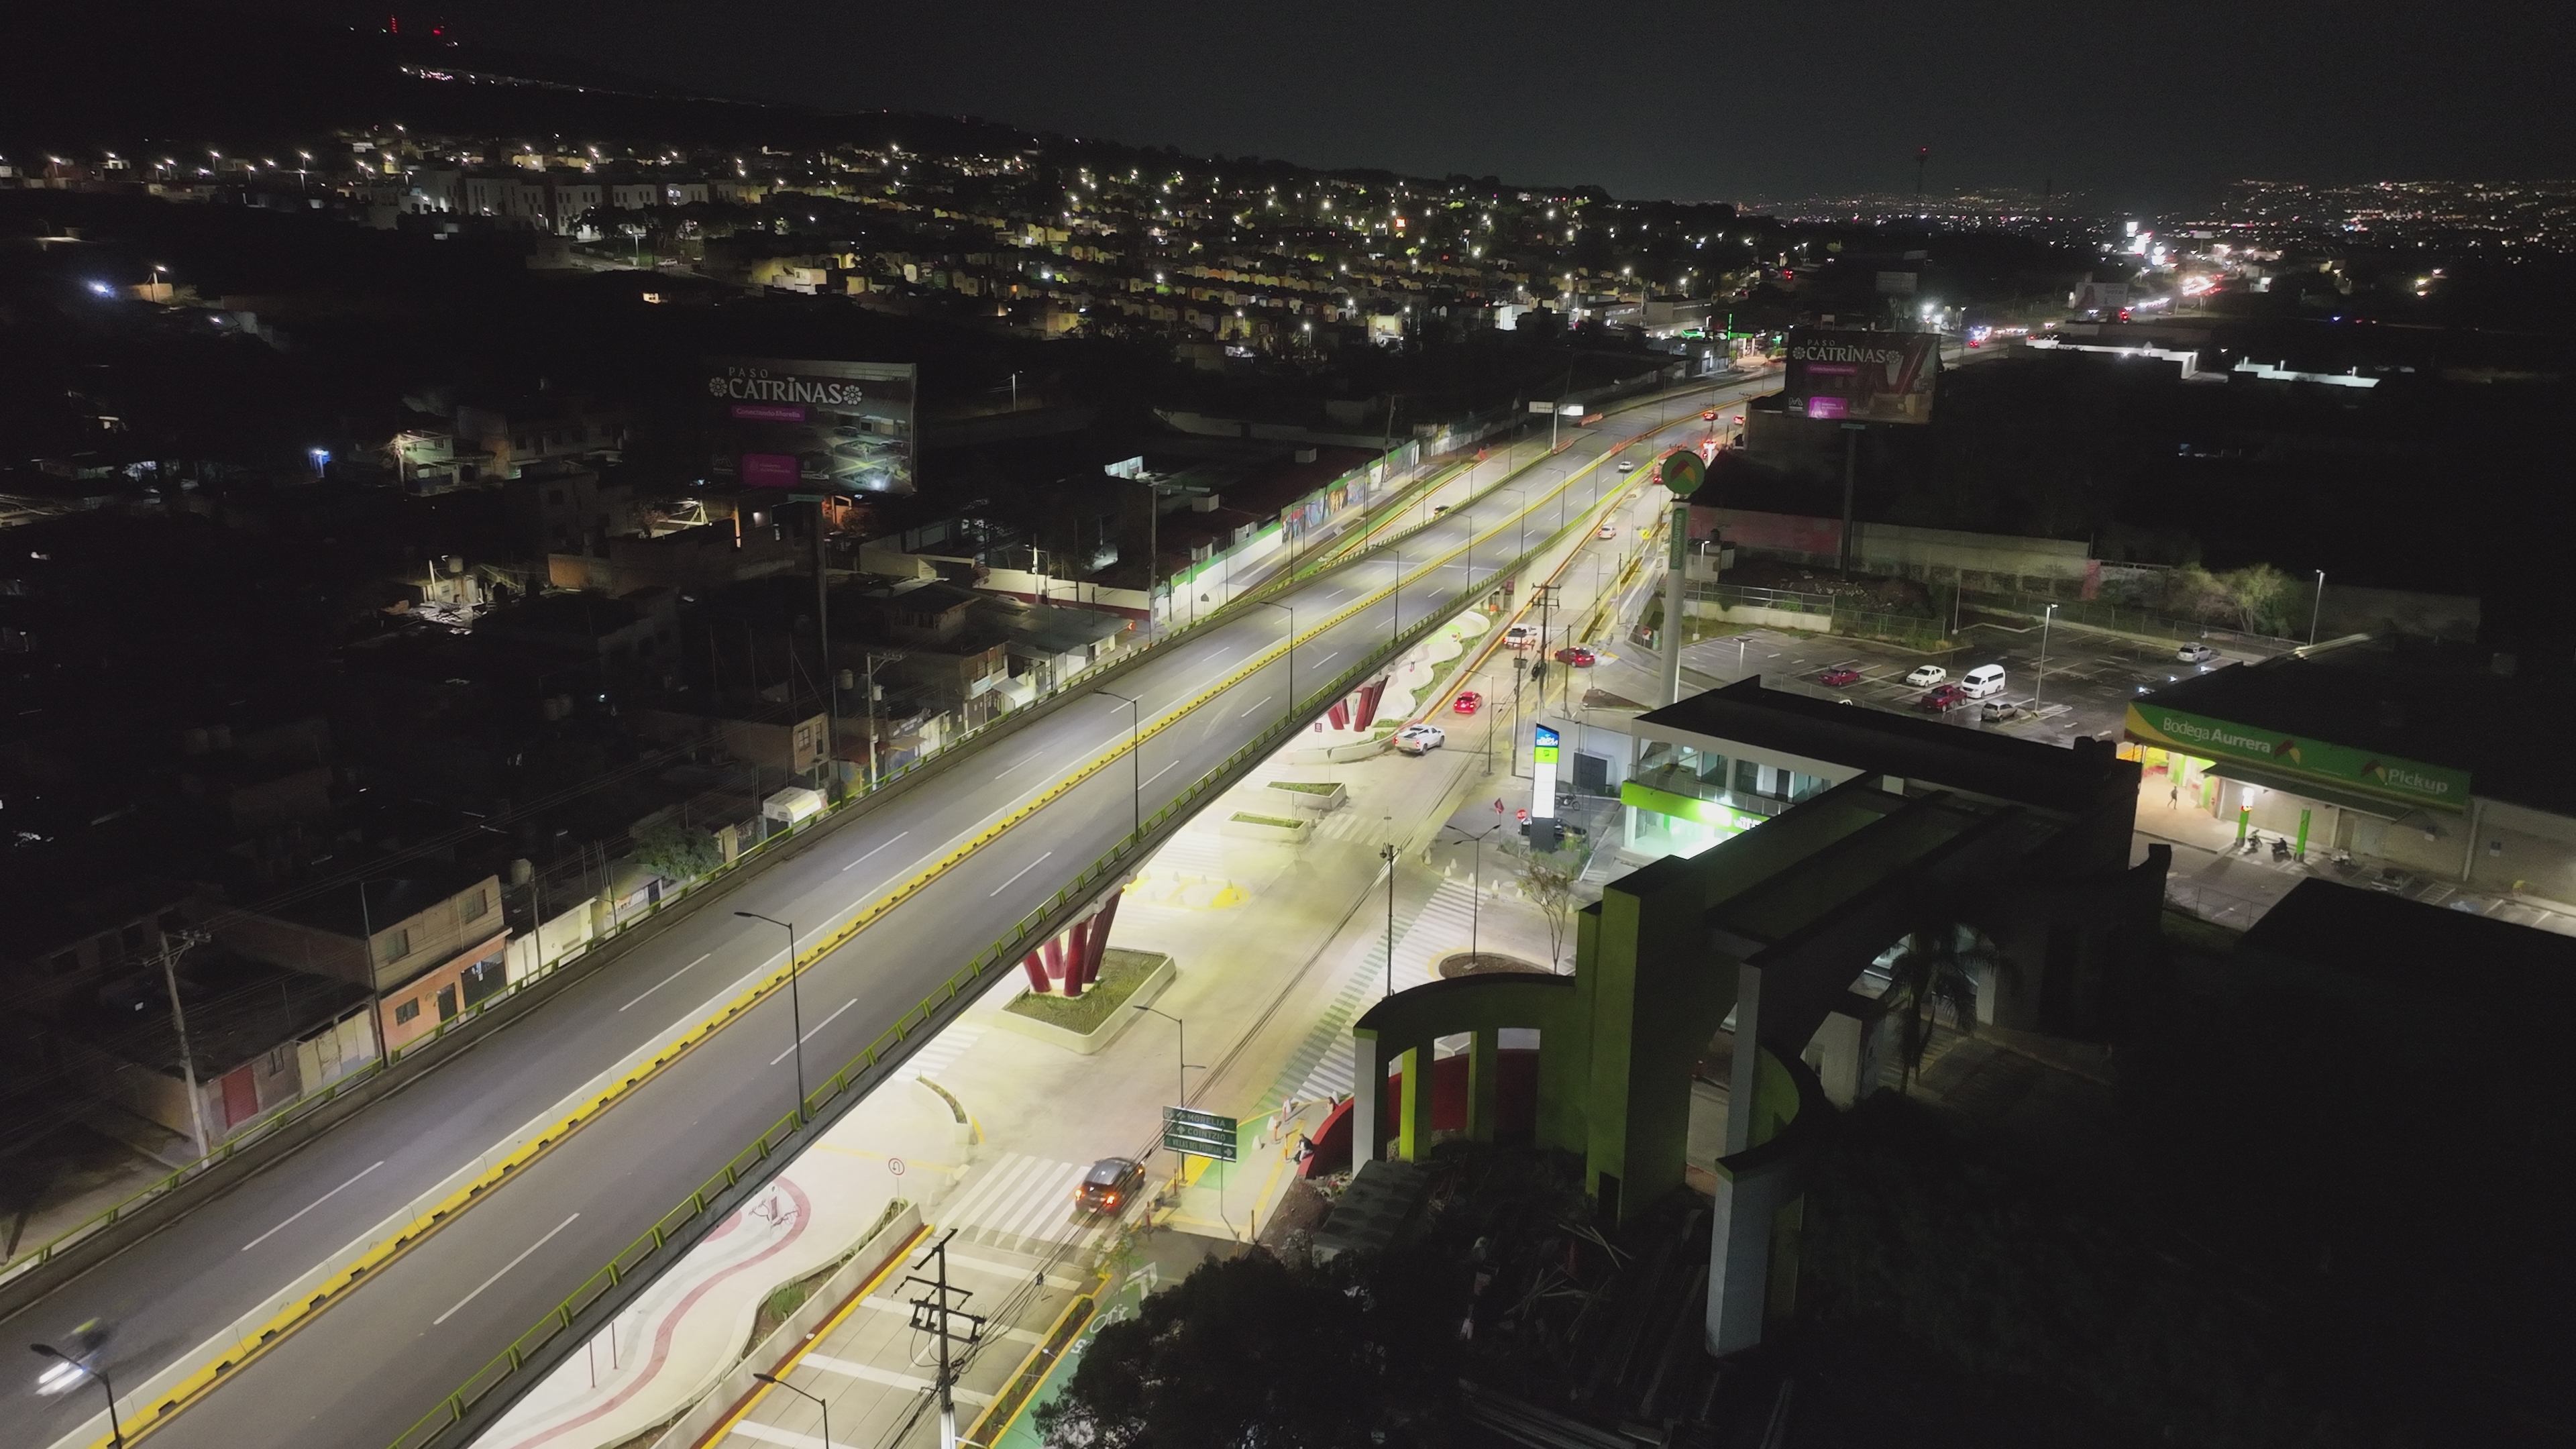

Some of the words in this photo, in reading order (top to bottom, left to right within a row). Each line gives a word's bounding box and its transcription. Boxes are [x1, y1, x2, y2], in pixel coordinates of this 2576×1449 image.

[1806, 345, 1886, 363] CATRINAS
[729, 366, 769, 378] PASO
[729, 377, 843, 405] CATRINAS
[736, 408, 775, 417] Conectando
[2163, 717, 2210, 741] Bodega
[2211, 729, 2271, 754] Aurrera
[2387, 769, 2448, 794] Pickup
[1187, 1114, 1226, 1127] MORELIA
[1187, 1128, 1226, 1141] COINTZIO
[1173, 1138, 1188, 1148] VILLAS
[1189, 1141, 1198, 1150] DEL
